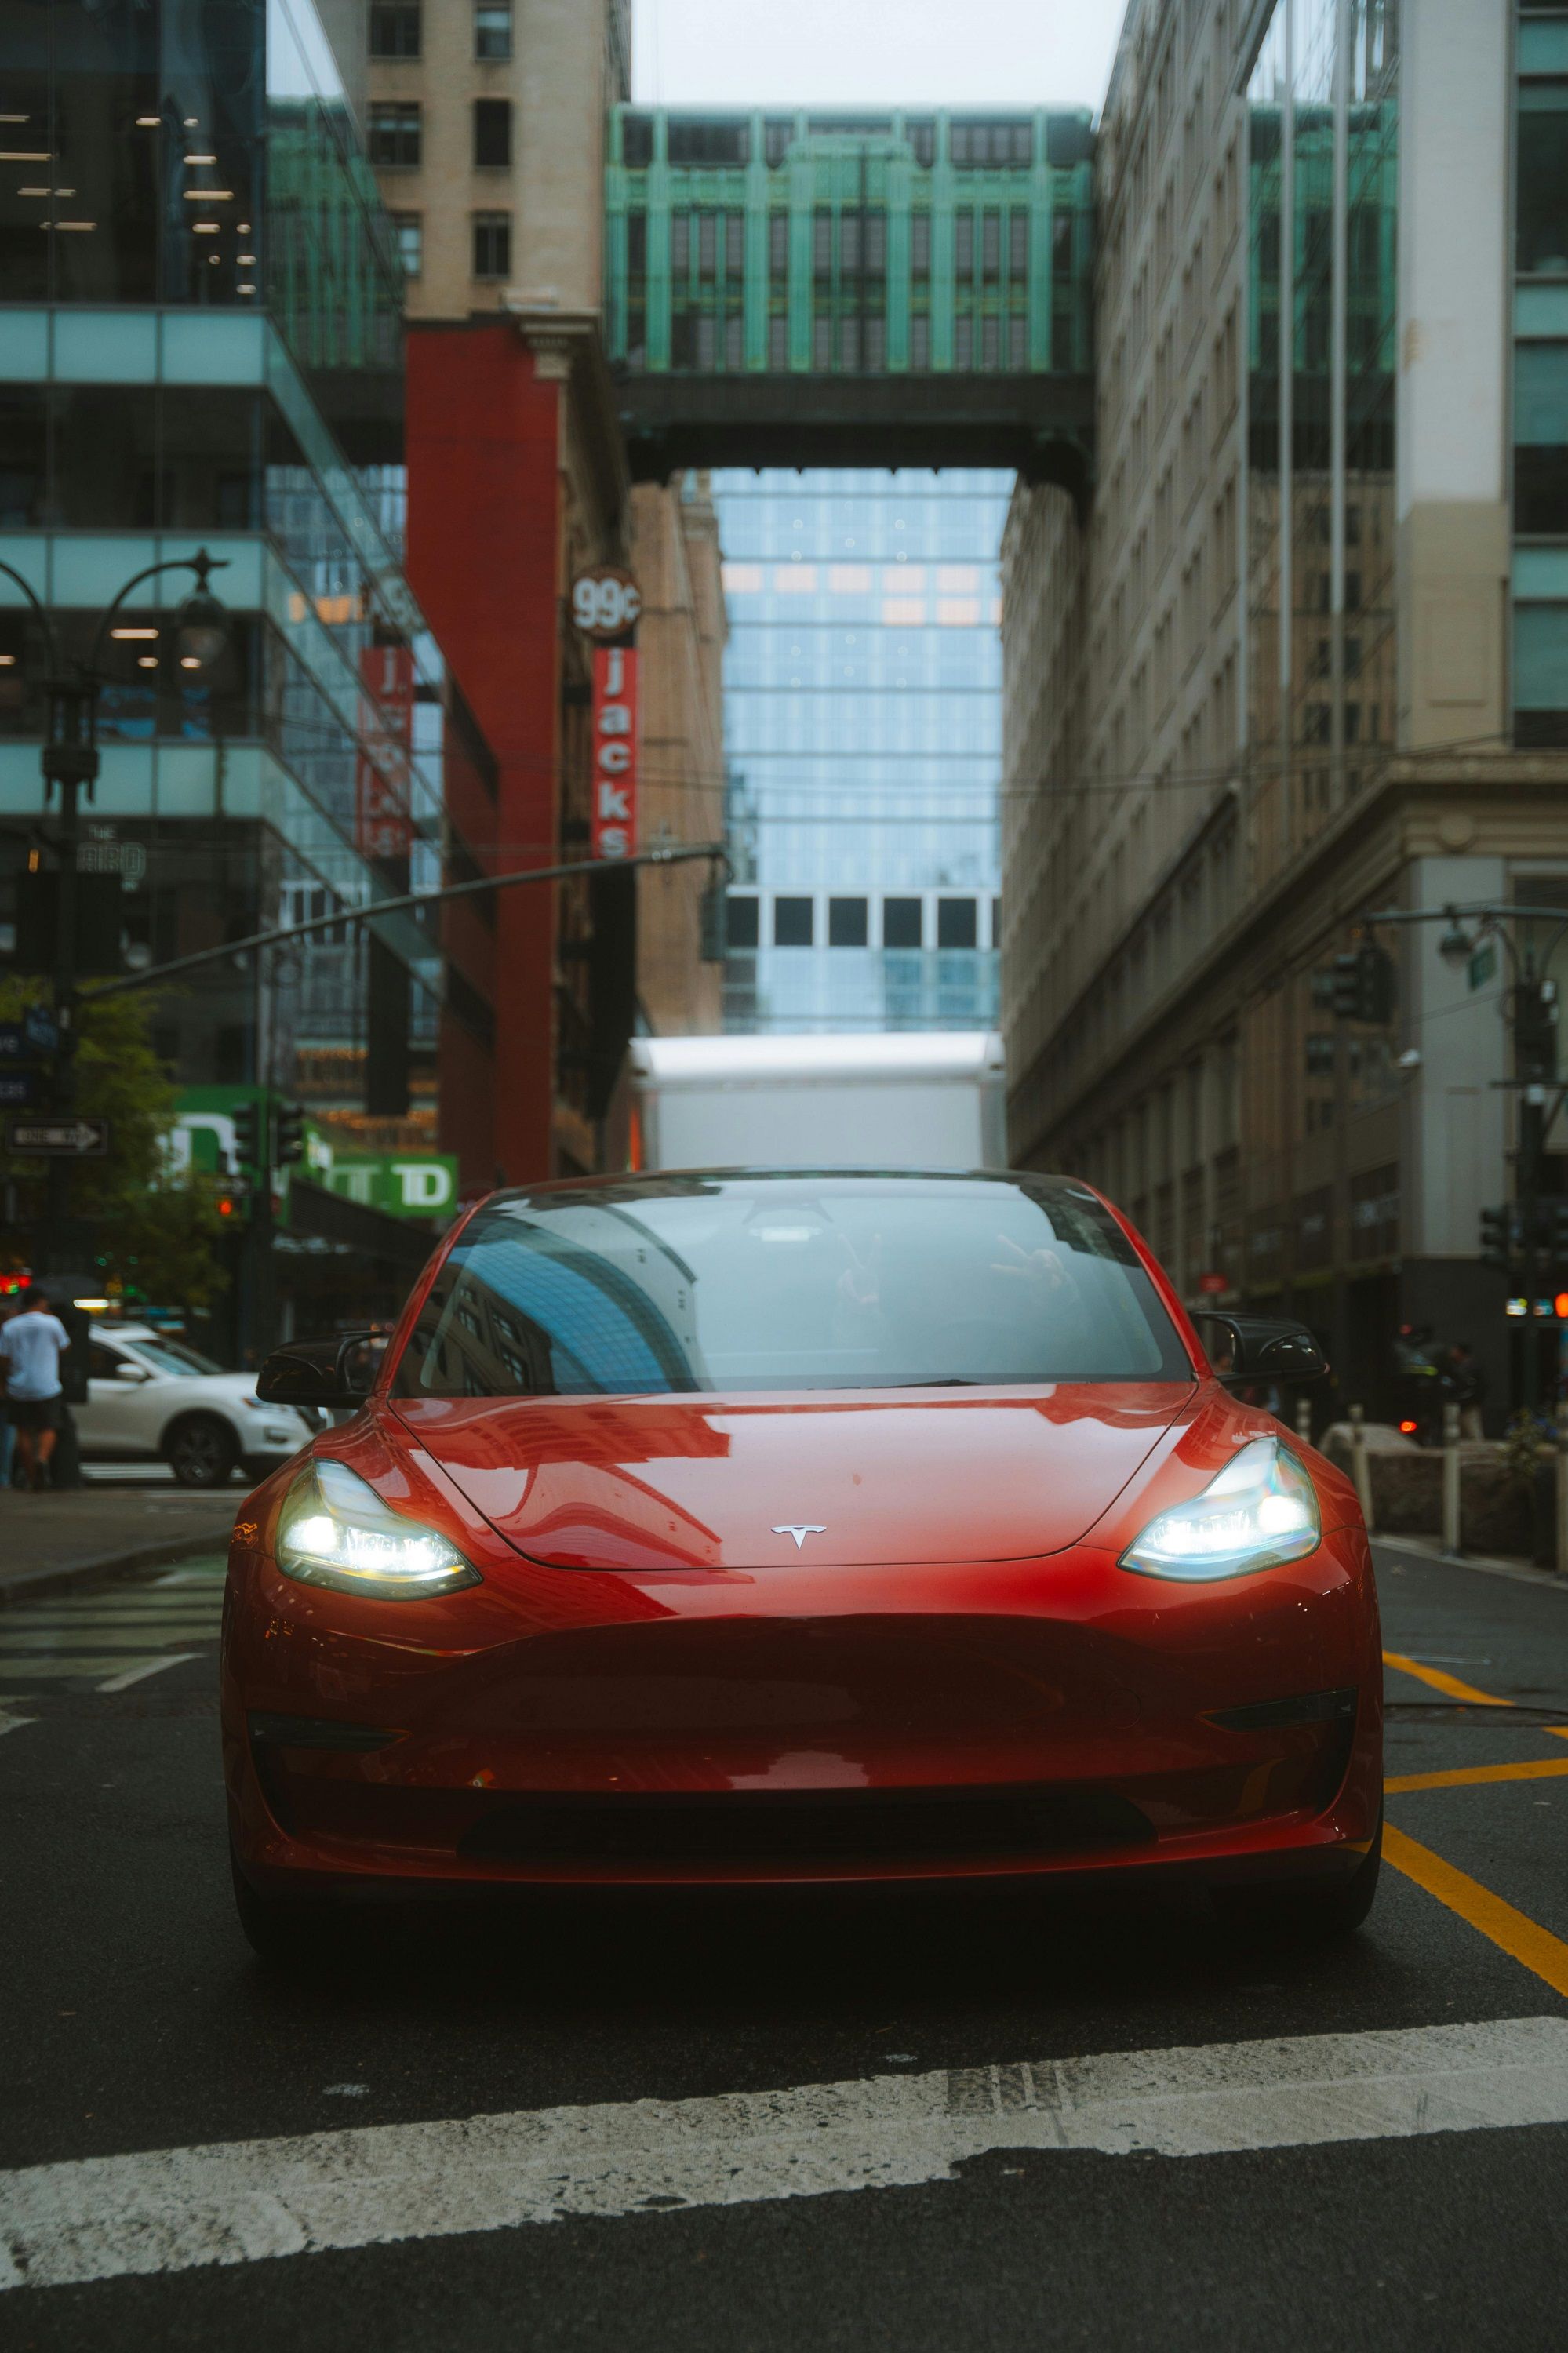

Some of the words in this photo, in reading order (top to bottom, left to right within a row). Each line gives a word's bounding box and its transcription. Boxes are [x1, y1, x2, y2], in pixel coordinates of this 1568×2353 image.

[573, 578, 641, 627] 99¢
[598, 648, 631, 857] jacks
[391, 1164, 451, 1206] TD
